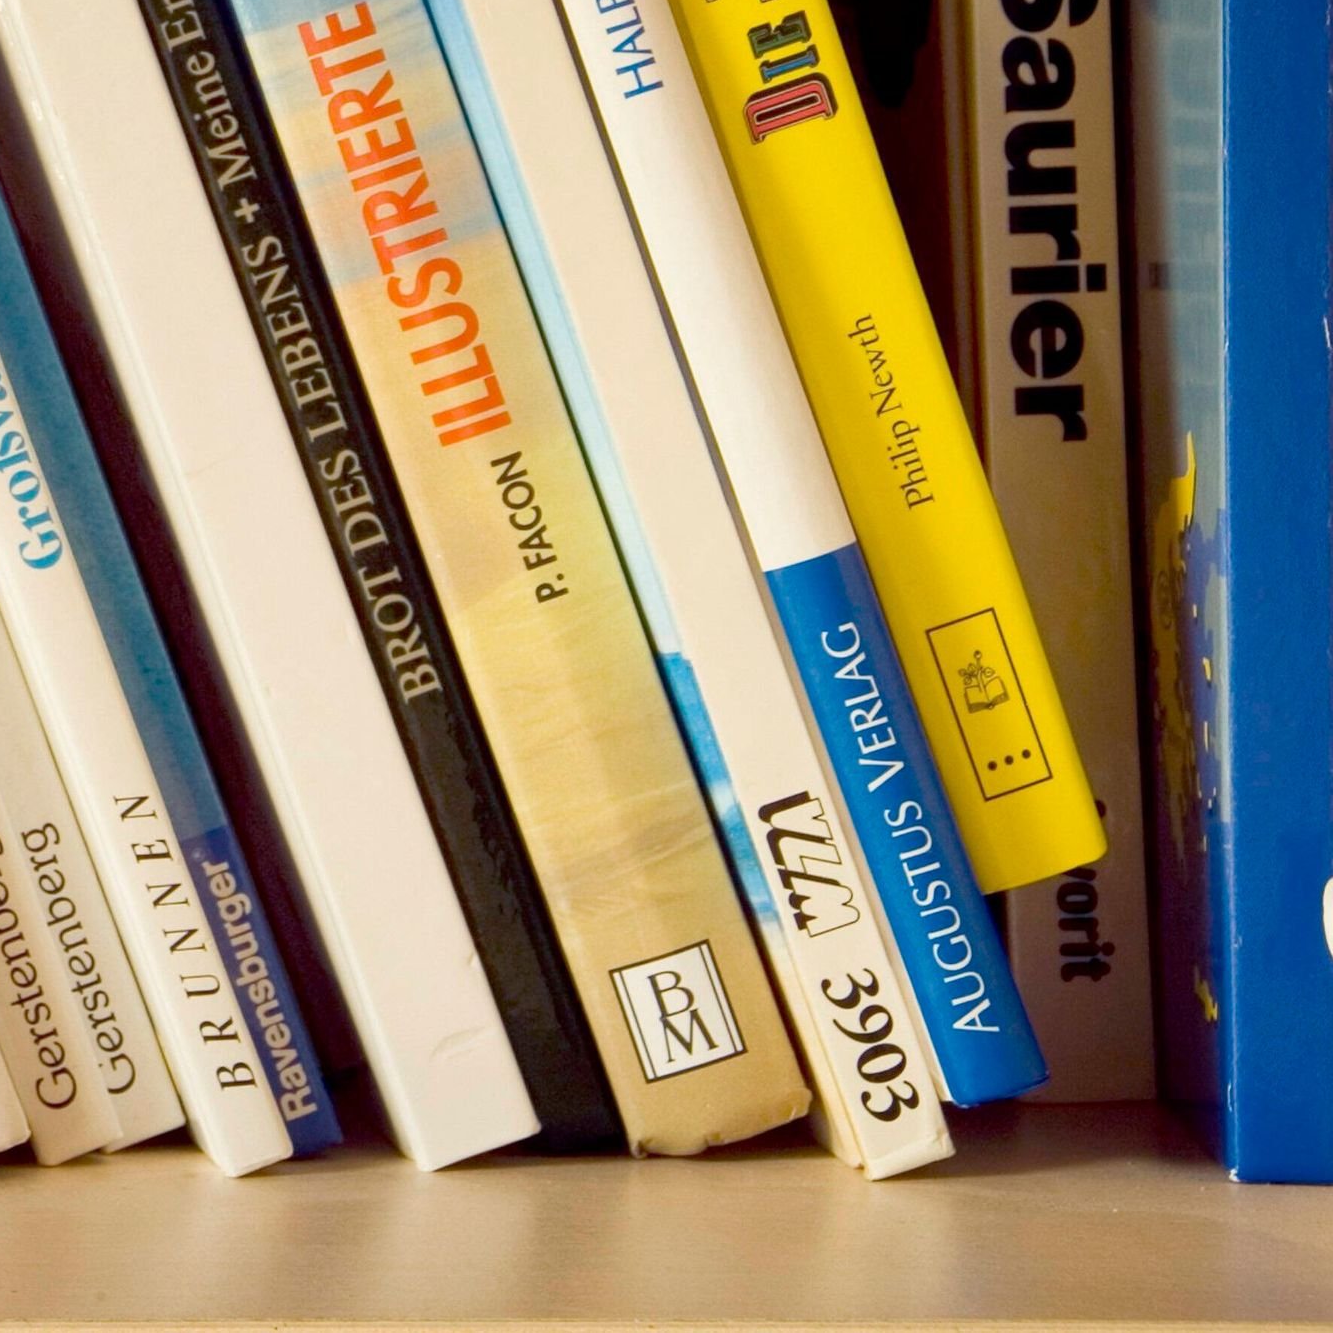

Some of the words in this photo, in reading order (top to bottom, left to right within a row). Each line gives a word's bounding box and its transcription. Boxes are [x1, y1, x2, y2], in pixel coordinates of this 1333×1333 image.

[186, 50, 259, 193] Meine
[742, 9, 838, 145] DIE
[234, 197, 260, 225] +
[300, 1, 512, 448] ILLUSTRIERTE
[242, 234, 348, 444] LEBENS
[847, 312, 907, 417] Newth
[325, 450, 393, 557] DES
[490, 451, 557, 572] FACON
[886, 412, 935, 511] Philip
[361, 563, 443, 703] BROT
[534, 569, 570, 604] P.
[822, 622, 901, 793] VERLAG
[22, 822, 136, 1095] Gerstenberg
[113, 792, 257, 1090] BRUNNEN
[882, 800, 999, 1033] AUGUSTUS
[200, 860, 317, 1123] Ravensburger
[822, 966, 919, 1125] 3903
